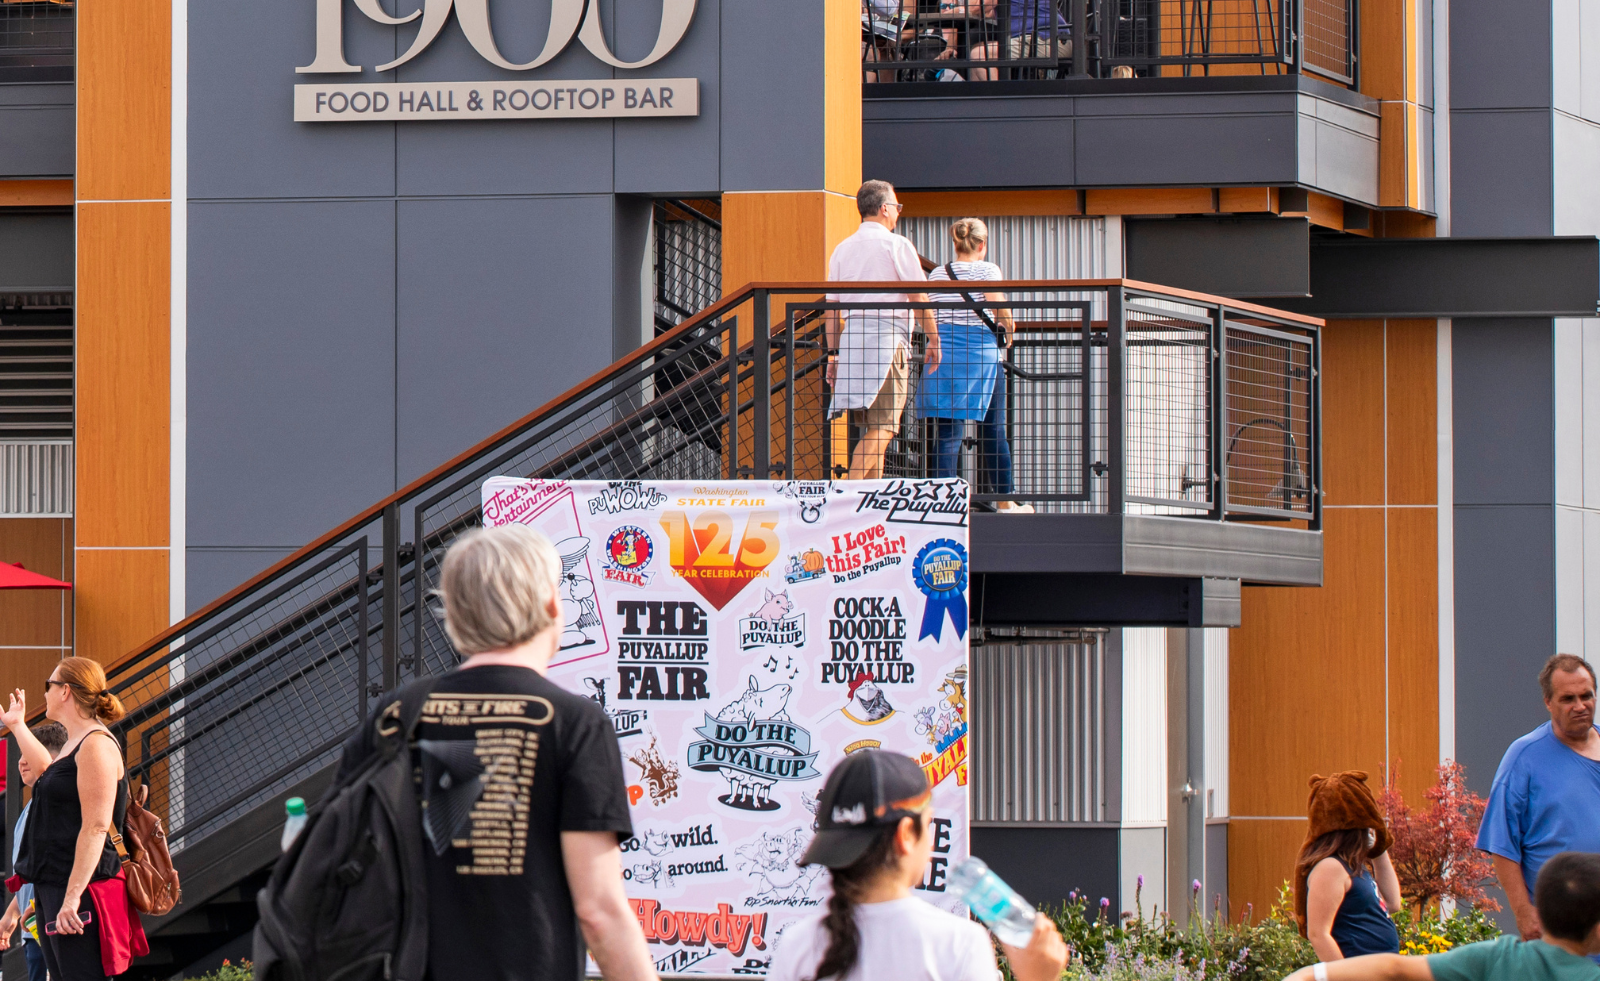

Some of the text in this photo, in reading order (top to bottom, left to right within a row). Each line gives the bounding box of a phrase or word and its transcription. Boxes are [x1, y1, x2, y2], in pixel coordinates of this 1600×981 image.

[315, 87, 674, 114] FOOD HALL & ROOFTOP BAR
[693, 487, 749, 498] Washington
[799, 486, 826, 495] FAIR
[677, 498, 766, 506] STATE FAIR
[856, 490, 890, 513] The
[659, 510, 781, 568] 125
[831, 524, 886, 554] I Love
[825, 535, 907, 573] this Fair!
[605, 569, 645, 587] FAIR
[671, 569, 770, 578] YEAR CELEBRATION
[833, 555, 902, 584] Do the Puyallup
[924, 560, 962, 575] PUYALLUP
[933, 572, 956, 586] FAIR
[617, 601, 708, 635] THE
[834, 597, 902, 618] COCK-A
[749, 620, 798, 632] DO THE
[829, 618, 907, 640] DOODLE
[742, 631, 803, 645] PUYALLUP
[618, 641, 709, 660] PUYALLUP
[831, 640, 903, 661] DO THE
[617, 666, 710, 700] FAIR
[715, 724, 797, 745] DO THE
[698, 745, 807, 778] PUYALLUP
[921, 752, 933, 765] the
[671, 824, 719, 848] wild.
[667, 854, 729, 877] around.
[743, 896, 761, 908] Rip
[799, 896, 825, 907] Fun!
[630, 898, 768, 958] Howdy!
